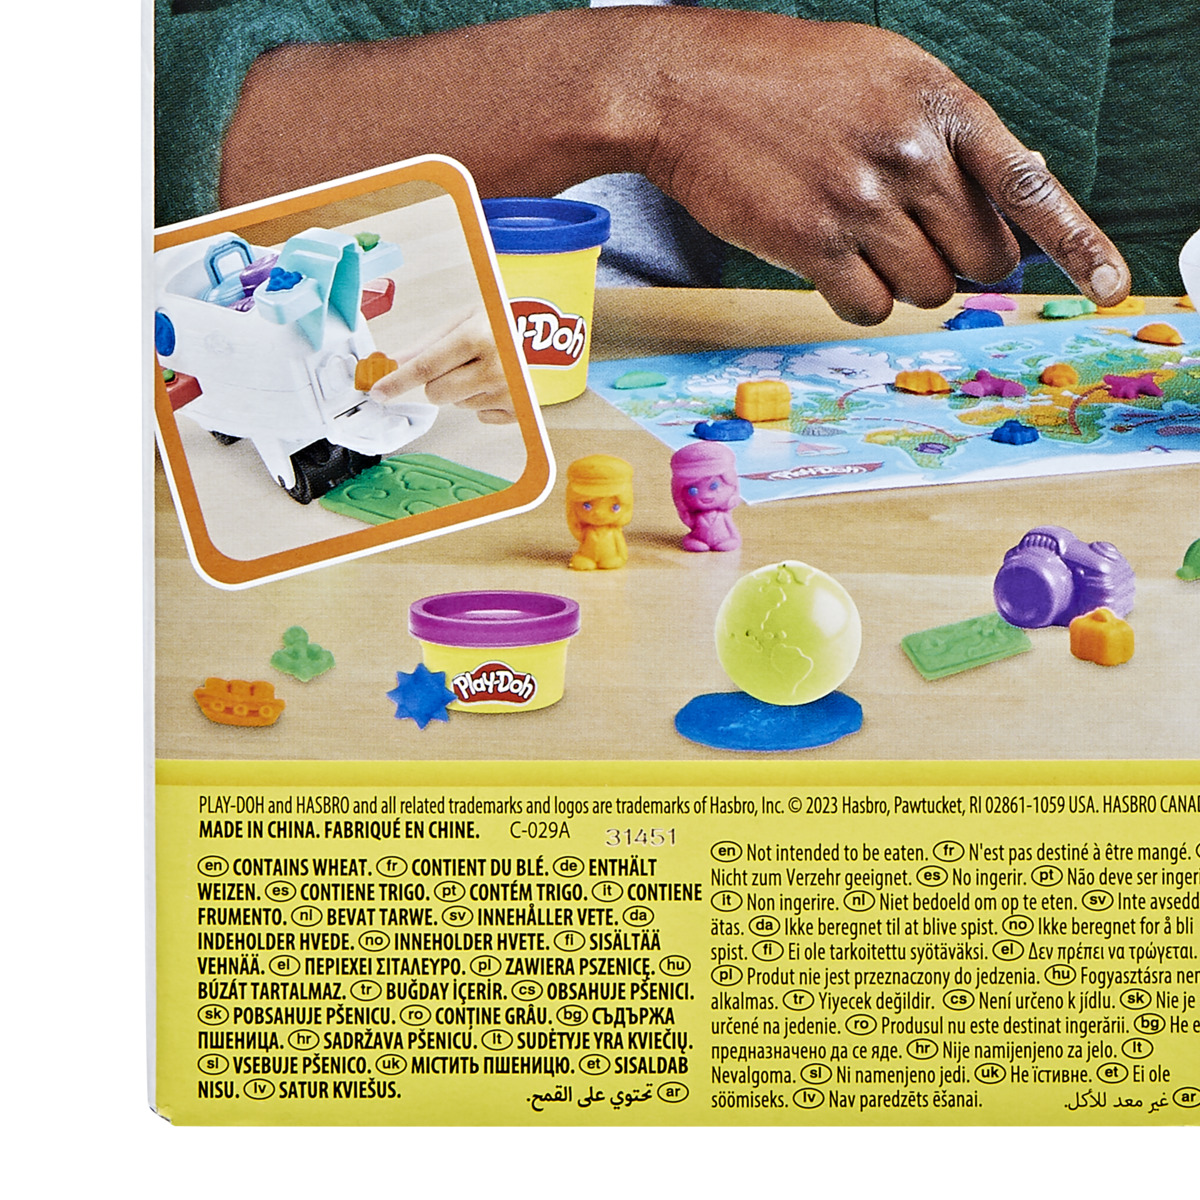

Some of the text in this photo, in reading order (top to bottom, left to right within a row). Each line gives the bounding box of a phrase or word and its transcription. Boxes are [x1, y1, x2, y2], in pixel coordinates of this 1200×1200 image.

[453, 669, 534, 700] Play-Doh
[199, 796, 264, 814] PLAY-DOH
[268, 796, 292, 814] and
[297, 796, 349, 814] HASBRO
[353, 796, 377, 814] and
[381, 796, 396, 814] all
[400, 796, 445, 814] related
[449, 796, 523, 814] trademarks
[526, 796, 550, 814] and
[555, 796, 589, 819] logos
[592, 801, 612, 814] are
[616, 796, 690, 814] trademarks
[694, 795, 707, 814] of
[710, 796, 758, 816] Hasbro,
[762, 796, 784, 814] Inc.
[788, 797, 802, 813] ©
[806, 796, 838, 814] 2023
[843, 796, 890, 816] Hasbro,
[895, 795, 965, 816] Pawtucket,
[970, 796, 981, 813] RI
[985, 796, 1065, 813] 02861-1059
[1069, 795, 1099, 813] USA.
[1103, 795, 1156, 813] HASBRO
[199, 817, 480, 841] MADE IN CHINA. FABRIQUÉ EN CHINE.
[510, 821, 570, 838] C-029A
[605, 827, 677, 847] 31451
[718, 847, 735, 856] en
[747, 843, 772, 861] Not
[776, 843, 839, 861] intended
[844, 845, 858, 861] to
[863, 843, 879, 861] be
[884, 845, 928, 861] eaten.
[943, 844, 955, 856] fr
[969, 843, 1004, 861] N'est
[1009, 848, 1032, 865] pas
[1037, 843, 1088, 861] destiné
[1093, 843, 1100, 860] à
[1105, 843, 1133, 860] être
[1138, 842, 1191, 865] mangé.
[205, 855, 657, 876] en CONTAINS WHEAT. fr CONTIENT DU BLÉ. de ENTHÄLT
[198, 978, 694, 1005] BÚZÁT TARTALMAZ. tr BUĞDAY İÇERİR. cs OBSAHUJE PŠENICI.
[207, 1053, 688, 1077] sl VSEBUJE PŠENICO. uk МІСТИТЬ ПШЕНИЦЮ. et SISALDAB
[198, 1077, 401, 1099] NISU. lv SATUR KVIEŠUS.
[711, 1089, 982, 1112] söömiseks. lv Nav paredzēts ēšanai.
